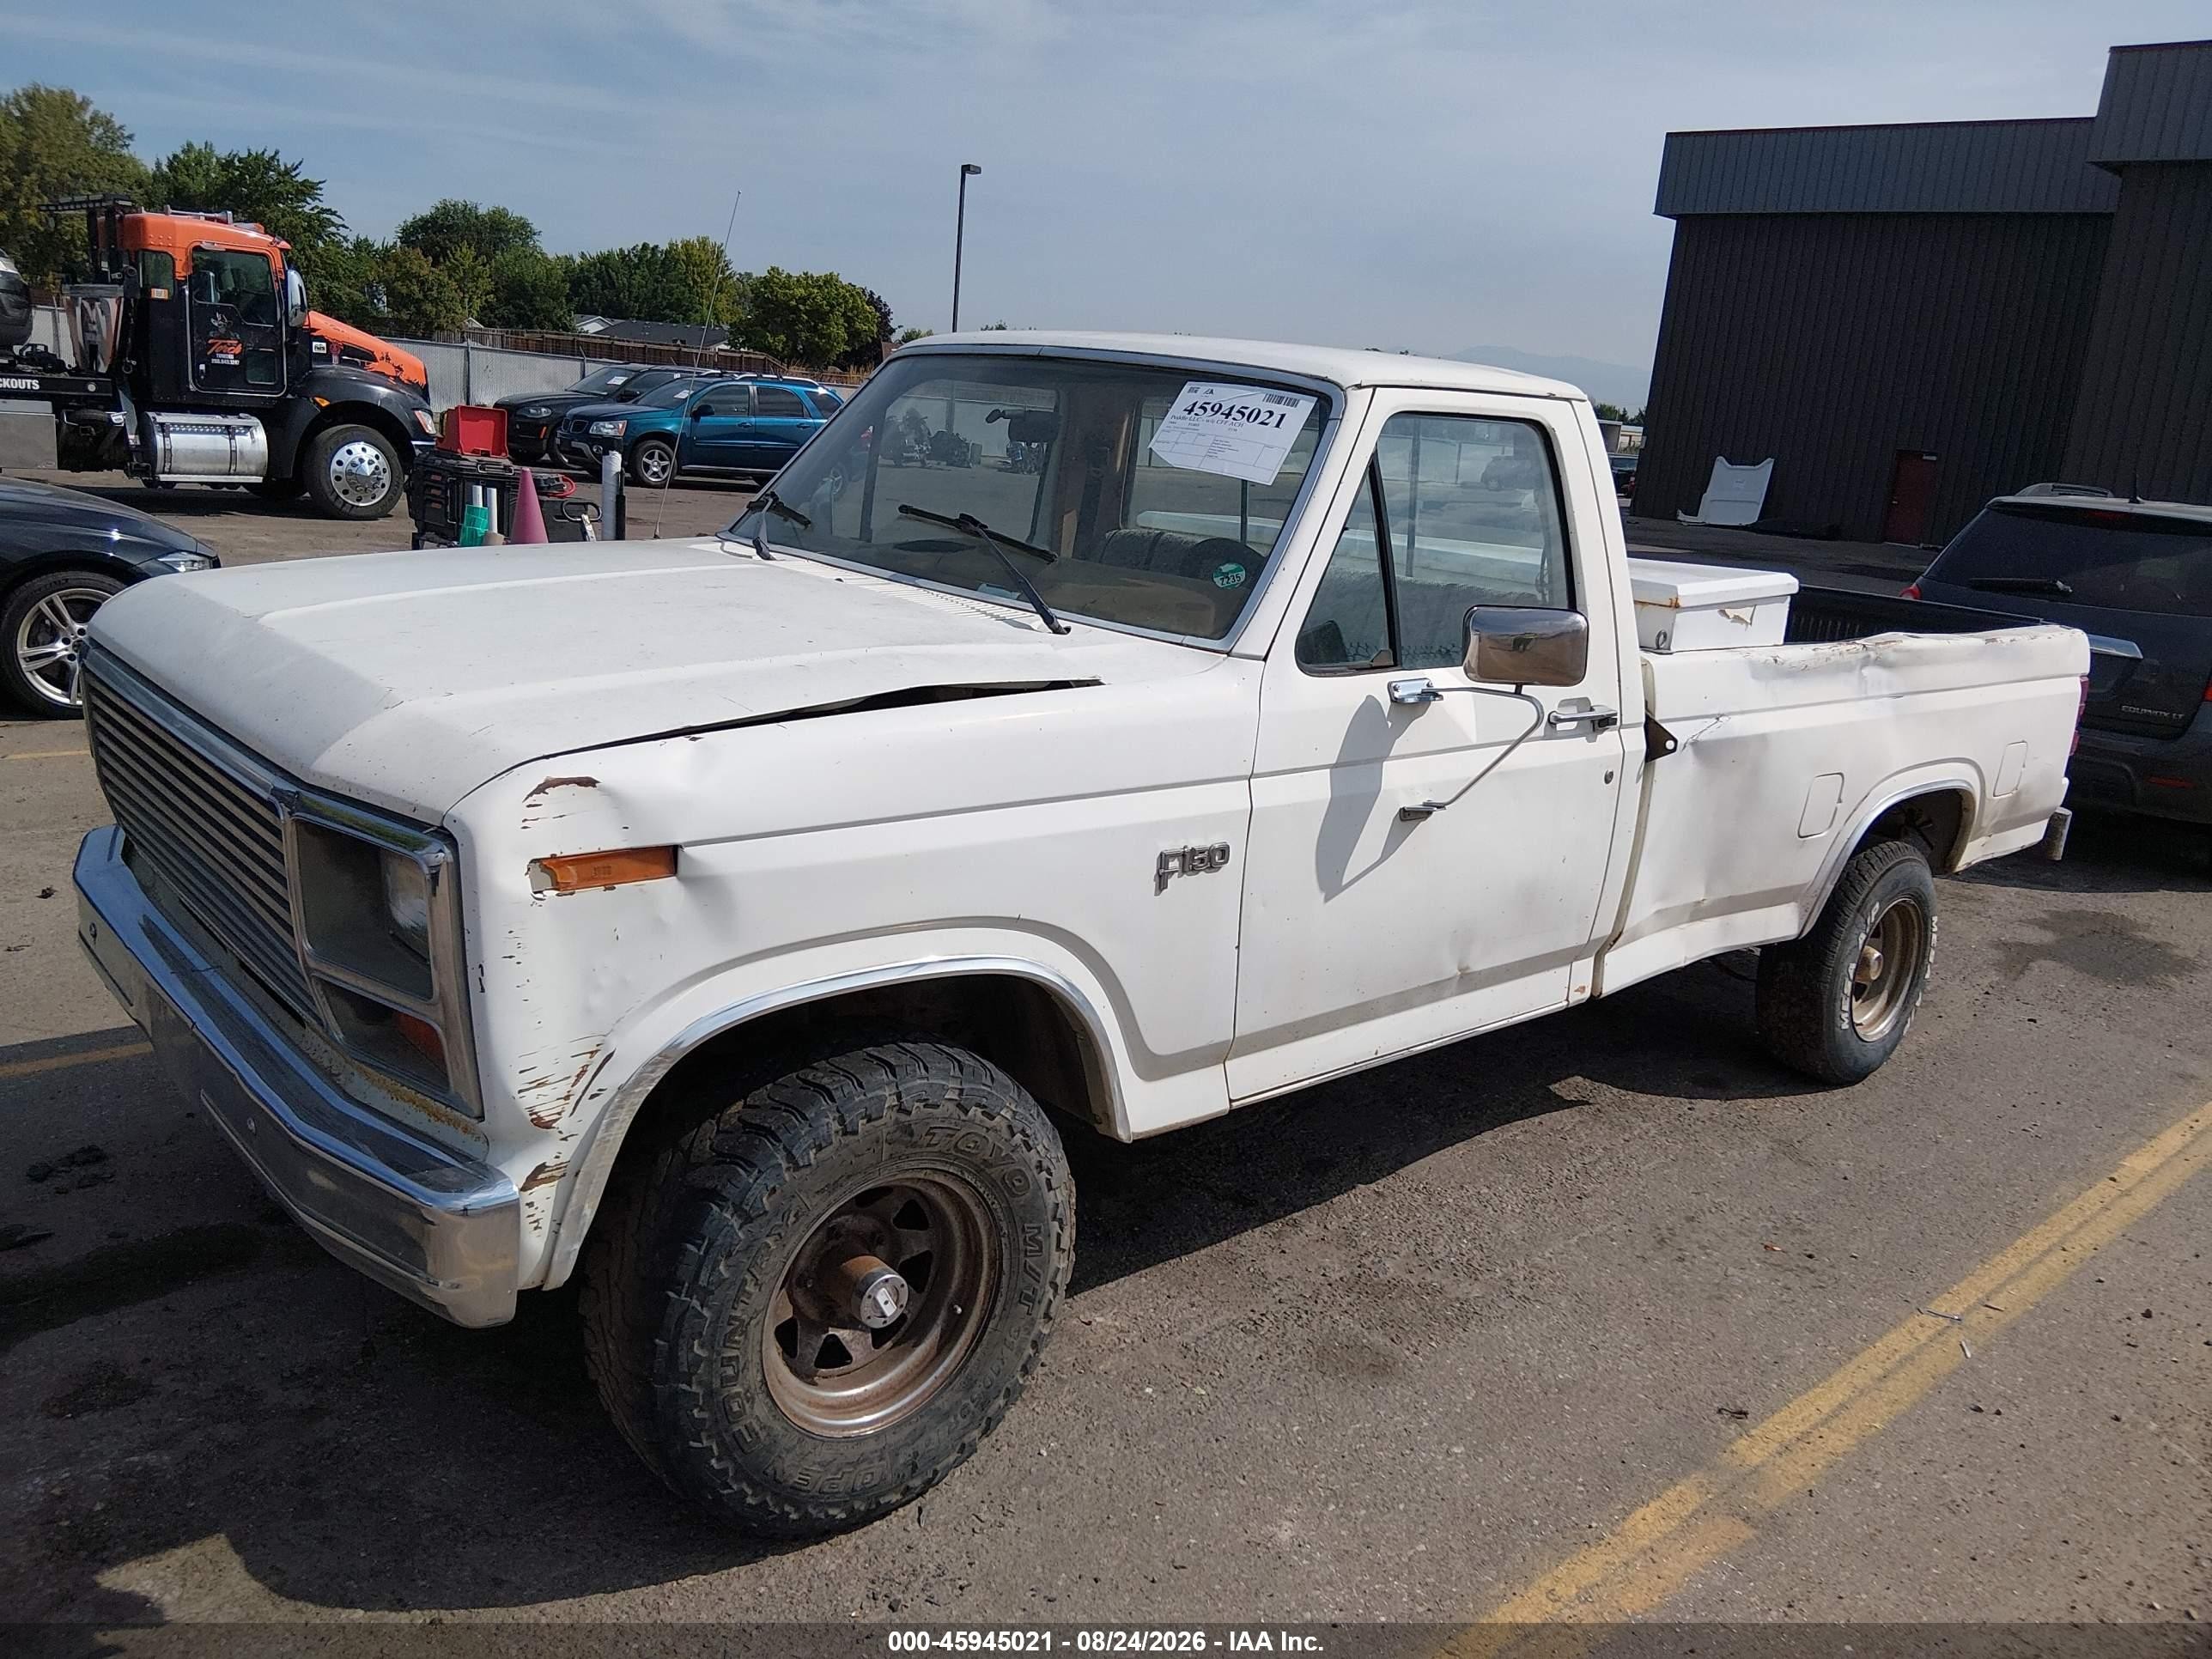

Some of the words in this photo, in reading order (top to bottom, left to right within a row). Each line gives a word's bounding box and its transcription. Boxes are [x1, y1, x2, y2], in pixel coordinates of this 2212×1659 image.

[1182, 400, 1287, 429] 45945021
[1155, 842, 1231, 891] F150
[924, 1125, 1031, 1199] TOYO
[763, 1455, 884, 1494] OPEN
